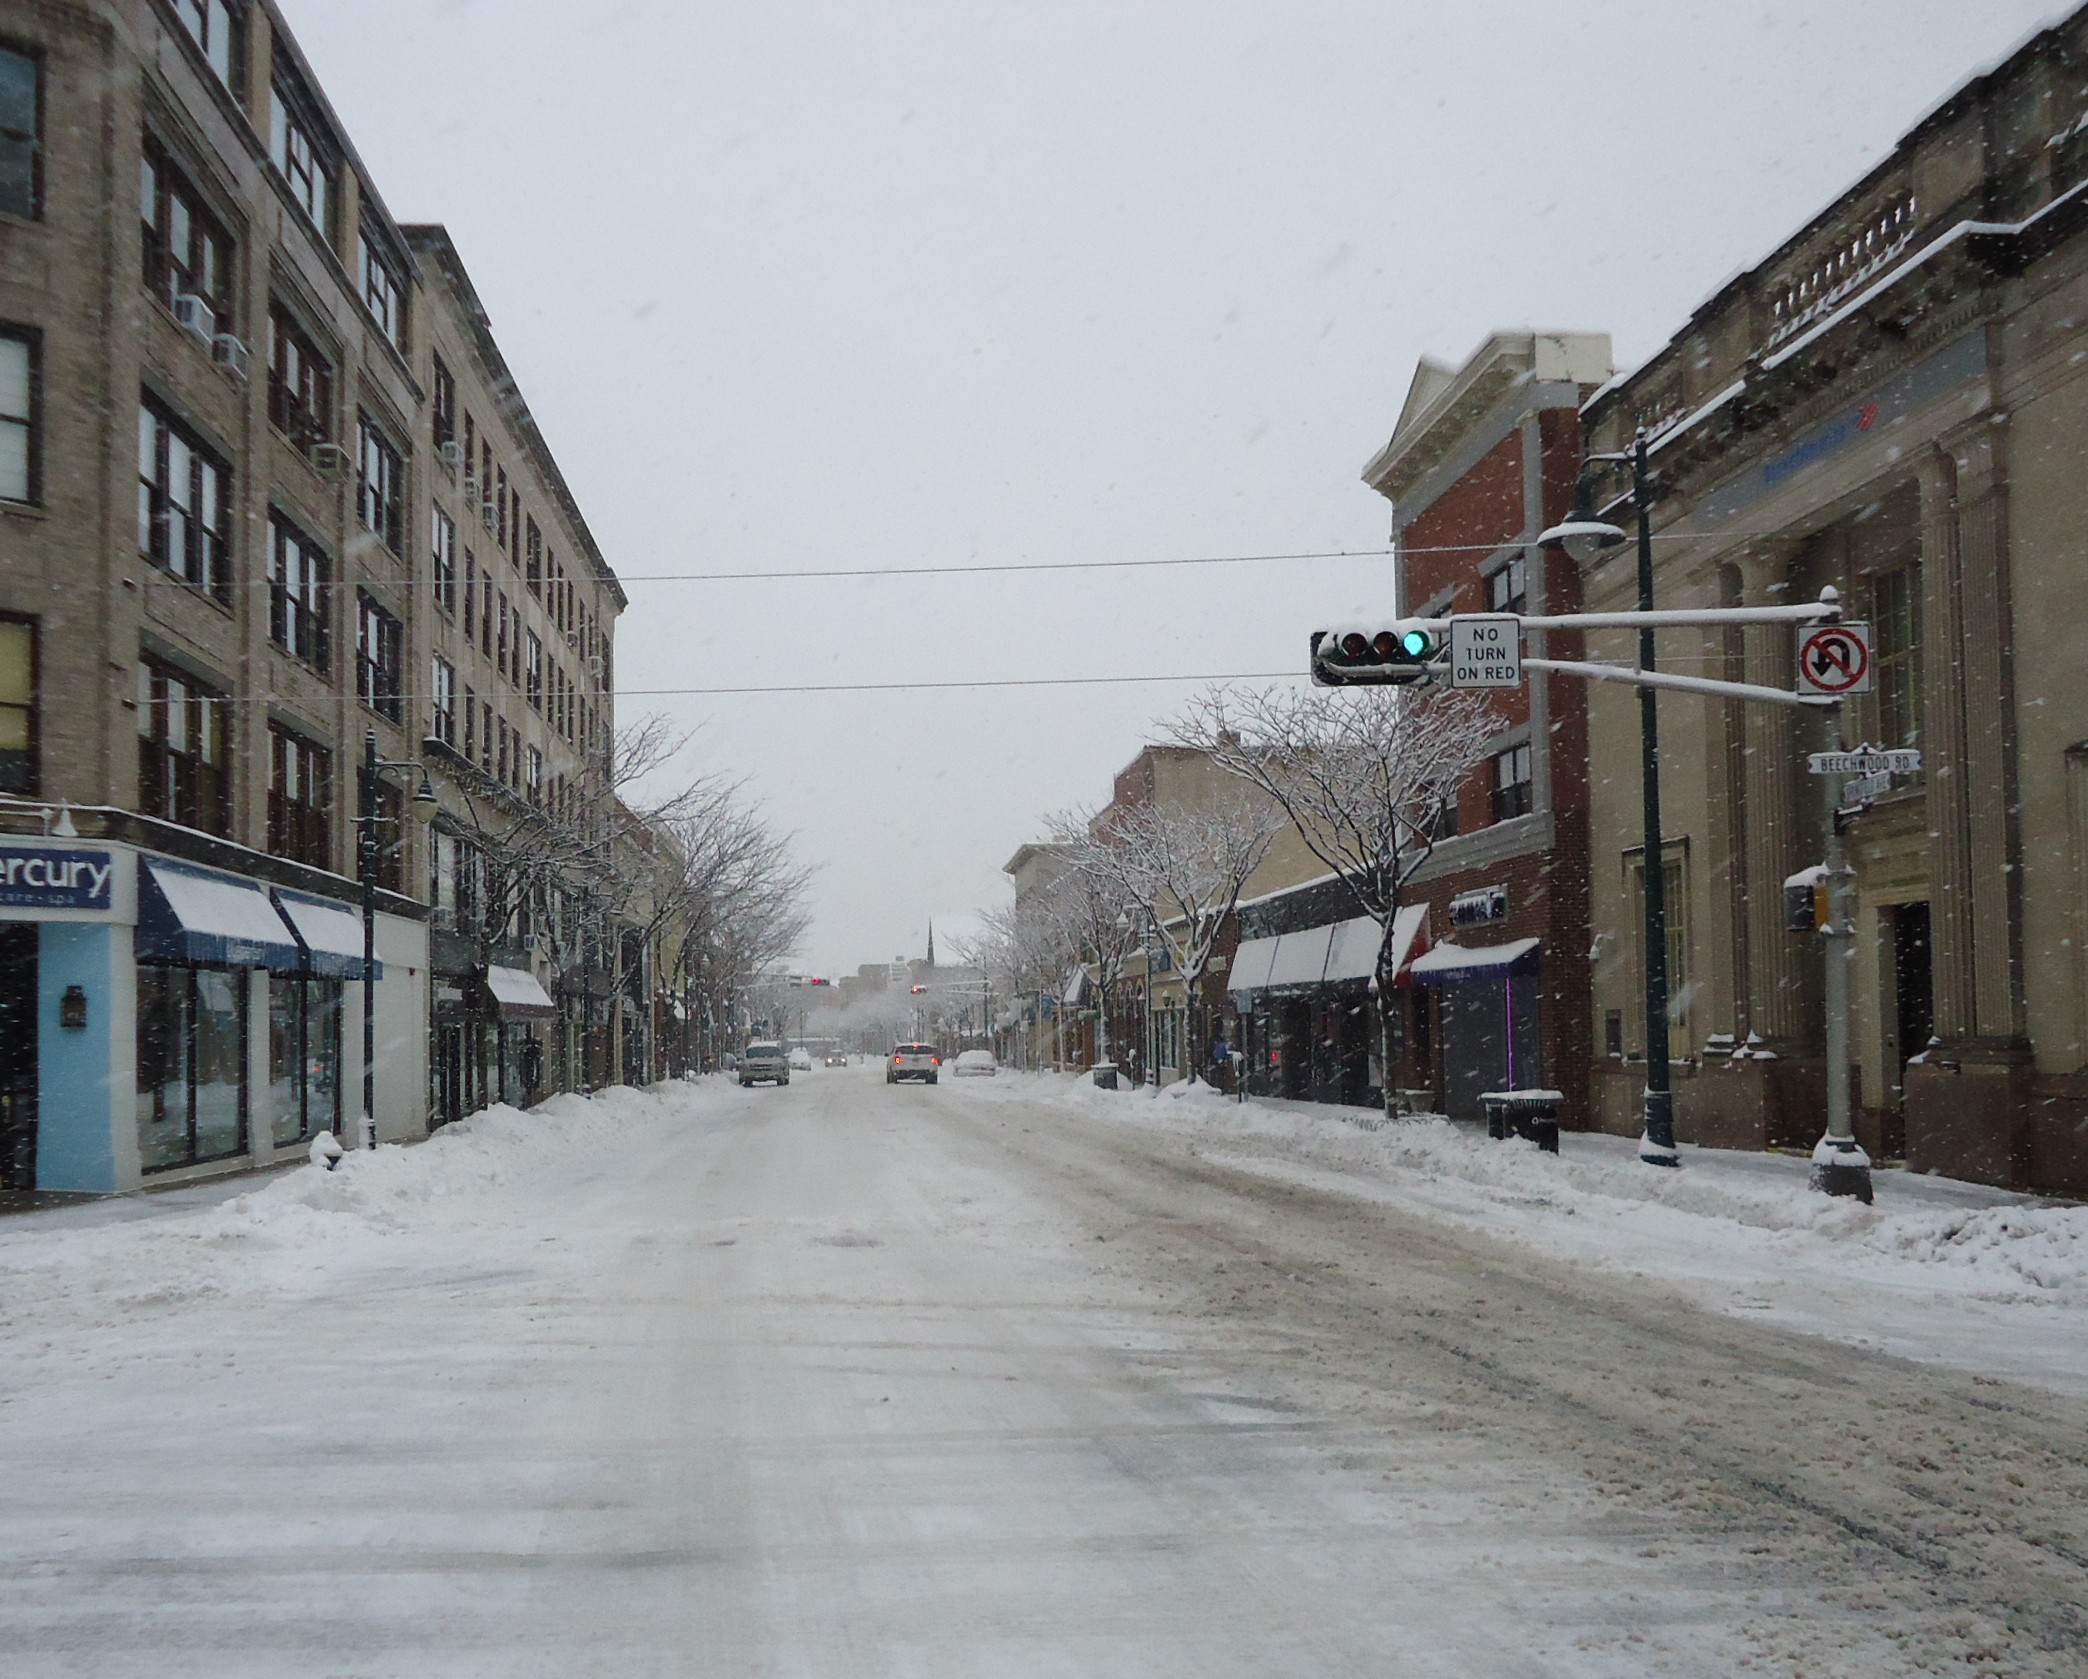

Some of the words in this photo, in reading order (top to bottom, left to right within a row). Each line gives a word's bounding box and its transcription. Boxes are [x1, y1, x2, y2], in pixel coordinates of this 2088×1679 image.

[1473, 628, 1498, 641] NO
[1466, 647, 1506, 660] TURN
[1457, 667, 1478, 680] ON
[1485, 666, 1515, 679] RED
[1821, 757, 1890, 771] BEECHWOOD
[1895, 756, 1910, 769] RD
[0, 858, 110, 898] rcury
